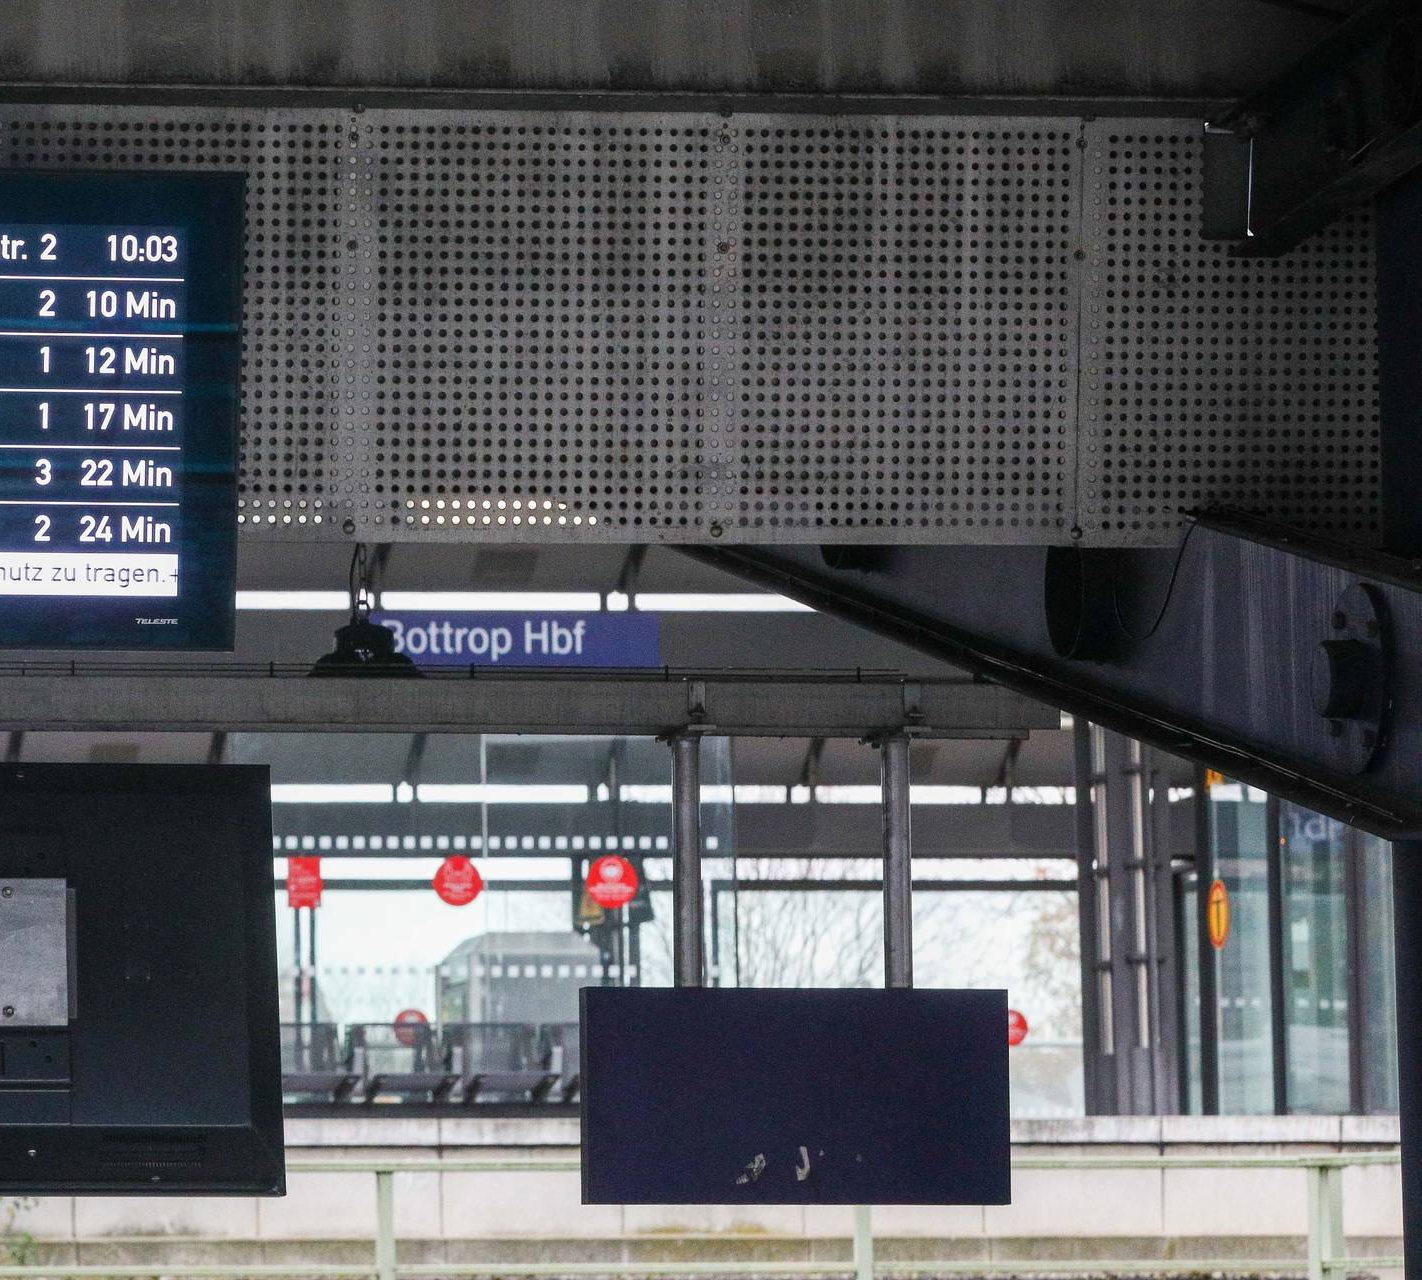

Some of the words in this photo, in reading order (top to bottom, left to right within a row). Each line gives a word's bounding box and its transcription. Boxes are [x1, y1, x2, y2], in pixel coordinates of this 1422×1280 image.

[41, 234, 56, 260] 2
[108, 235, 177, 261] 10:03
[39, 290, 55, 316] 2
[87, 291, 116, 317] 10
[127, 292, 175, 318] Min
[41, 347, 49, 372] 1
[86, 347, 115, 373] 12
[125, 348, 174, 373] Min
[40, 403, 48, 429] 1
[85, 403, 115, 429] 17
[124, 404, 173, 430] Min
[36, 459, 51, 485] 3
[81, 459, 113, 486] 22
[123, 460, 171, 486] Min
[35, 515, 50, 541] 2
[80, 515, 112, 542] 24
[122, 516, 170, 542] Min
[51, 568, 75, 581] zu
[524, 620, 585, 654] Hbf
